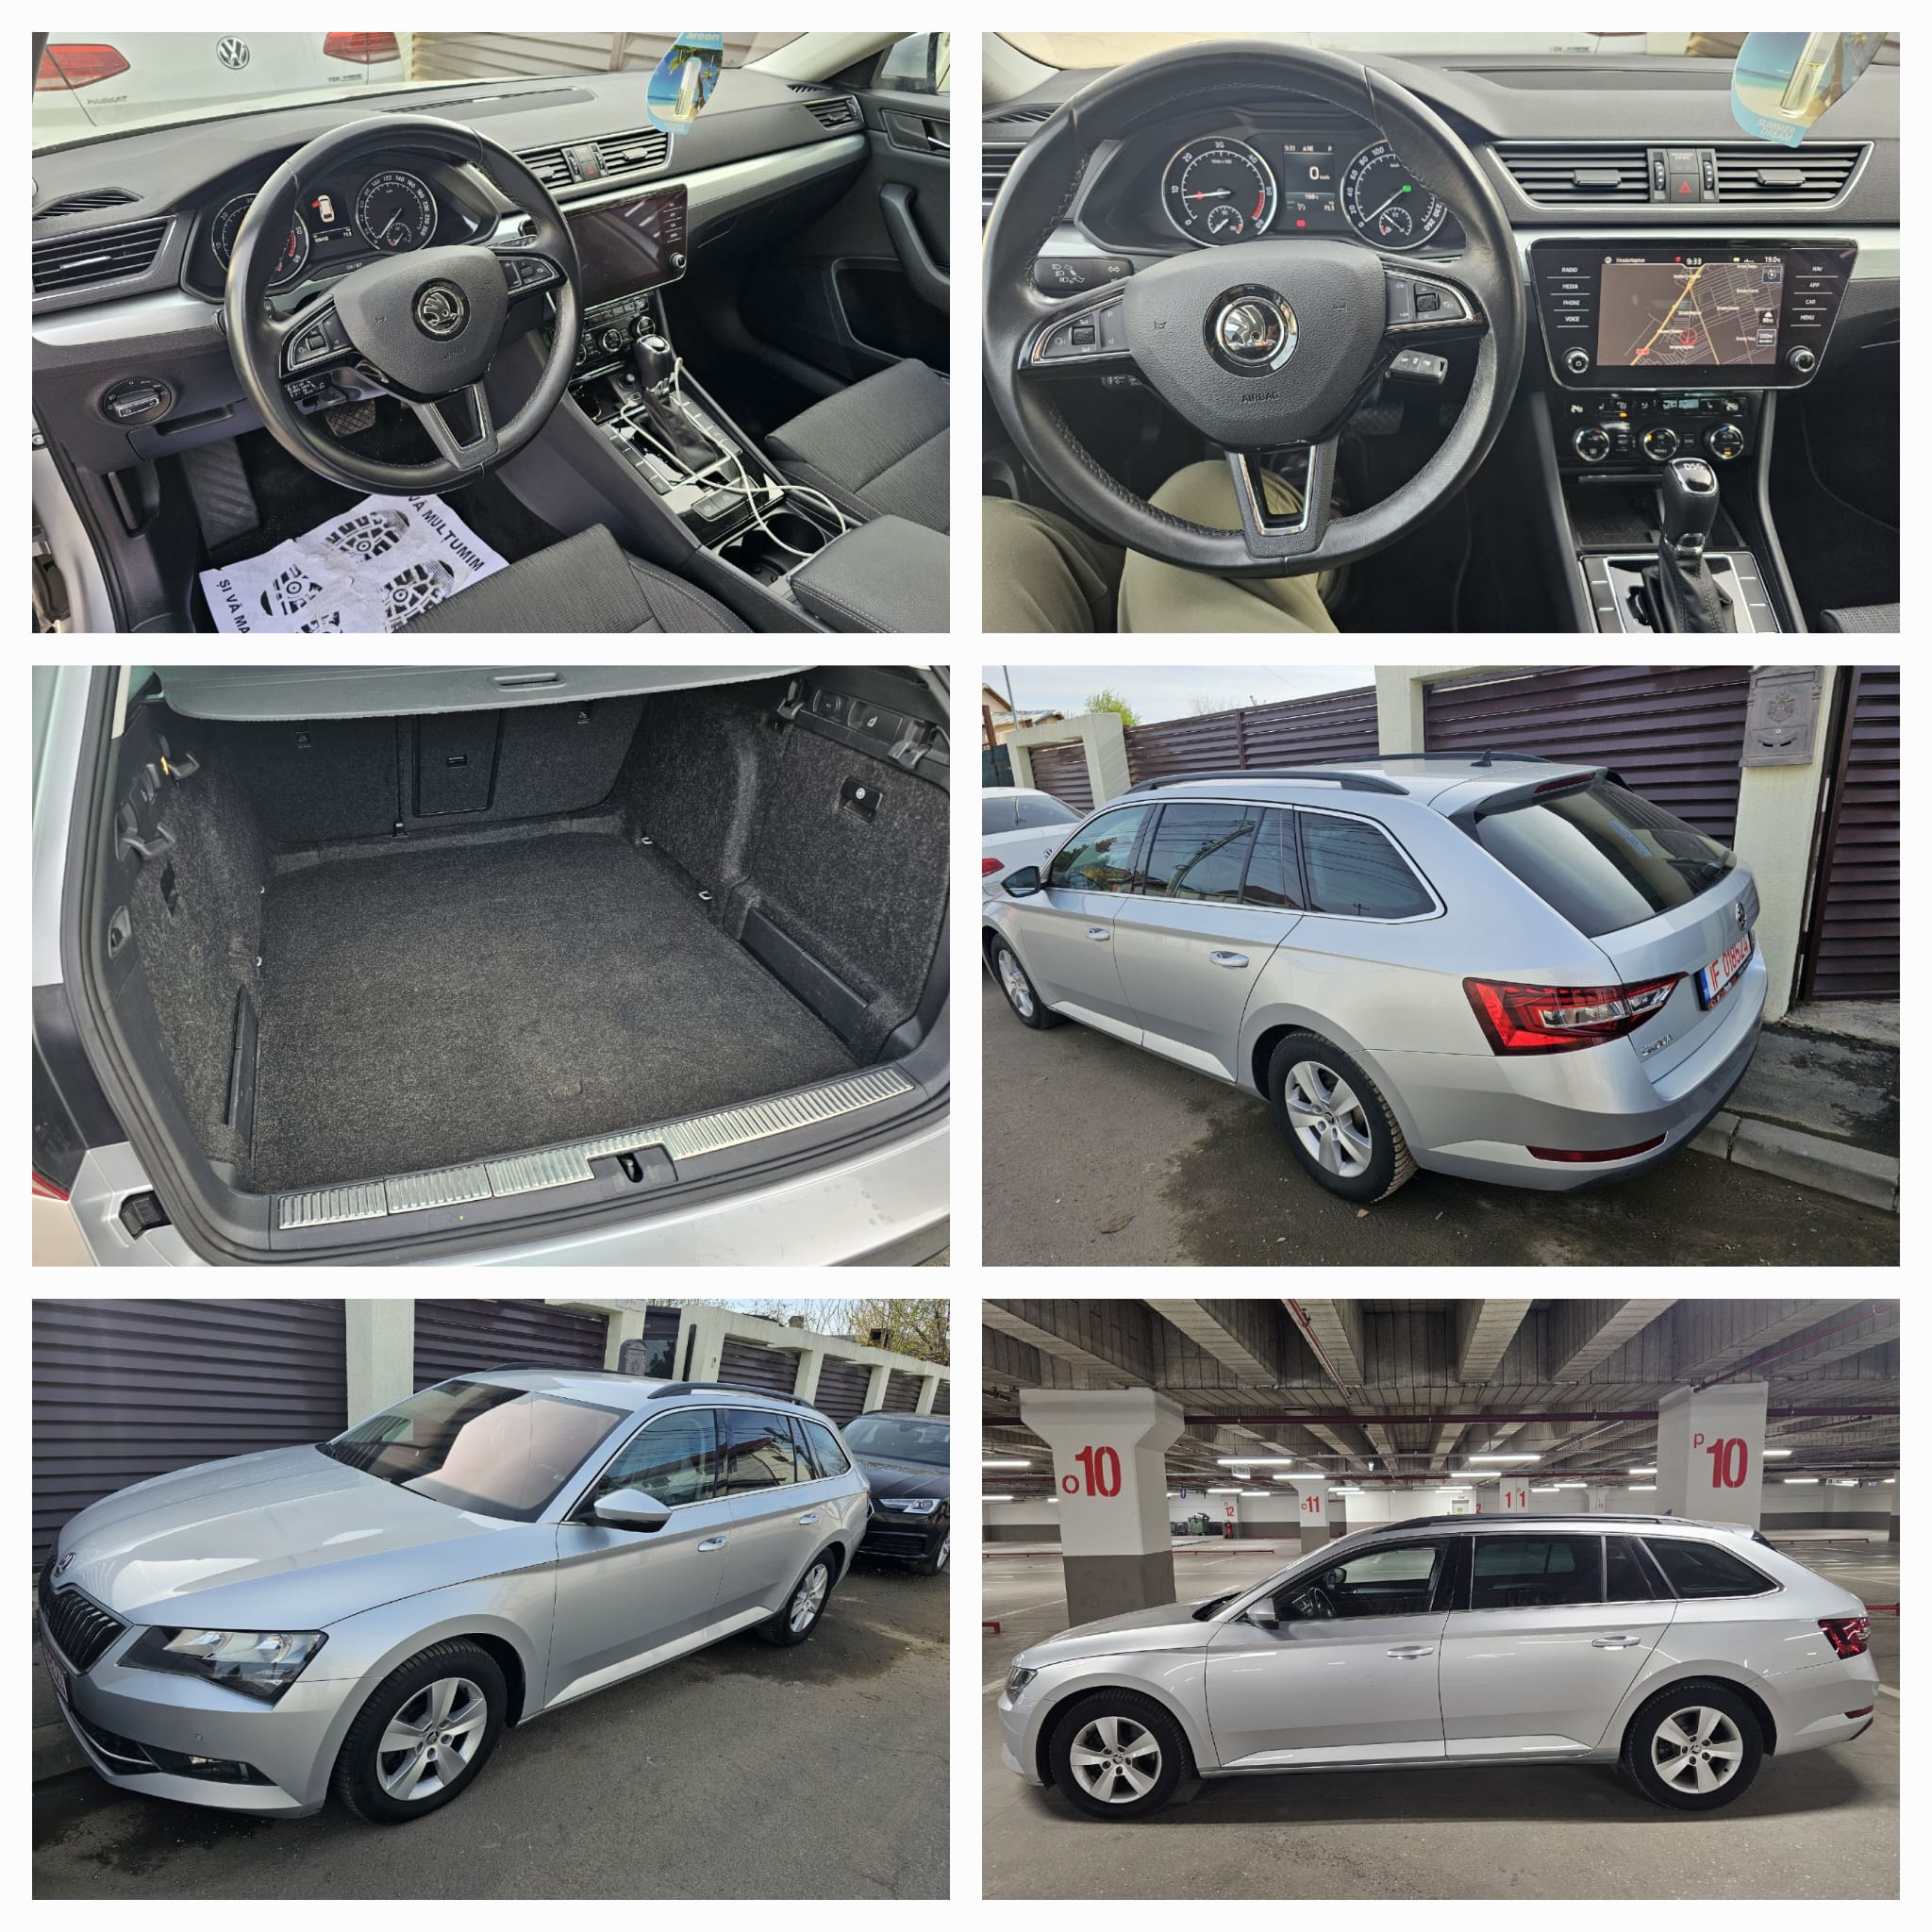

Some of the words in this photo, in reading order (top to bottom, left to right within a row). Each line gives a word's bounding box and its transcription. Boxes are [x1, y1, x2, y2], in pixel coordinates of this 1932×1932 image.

[1683, 462, 1704, 472] DSG
[422, 509, 485, 572] MULȚUMIM
[217, 579, 233, 592] ȘI
[226, 593, 243, 613] VĂ
[1709, 958, 1720, 991] IF
[1075, 1445, 1122, 1497] 10
[1706, 1438, 1748, 1489] 10
[1307, 1496, 1320, 1513] 11
